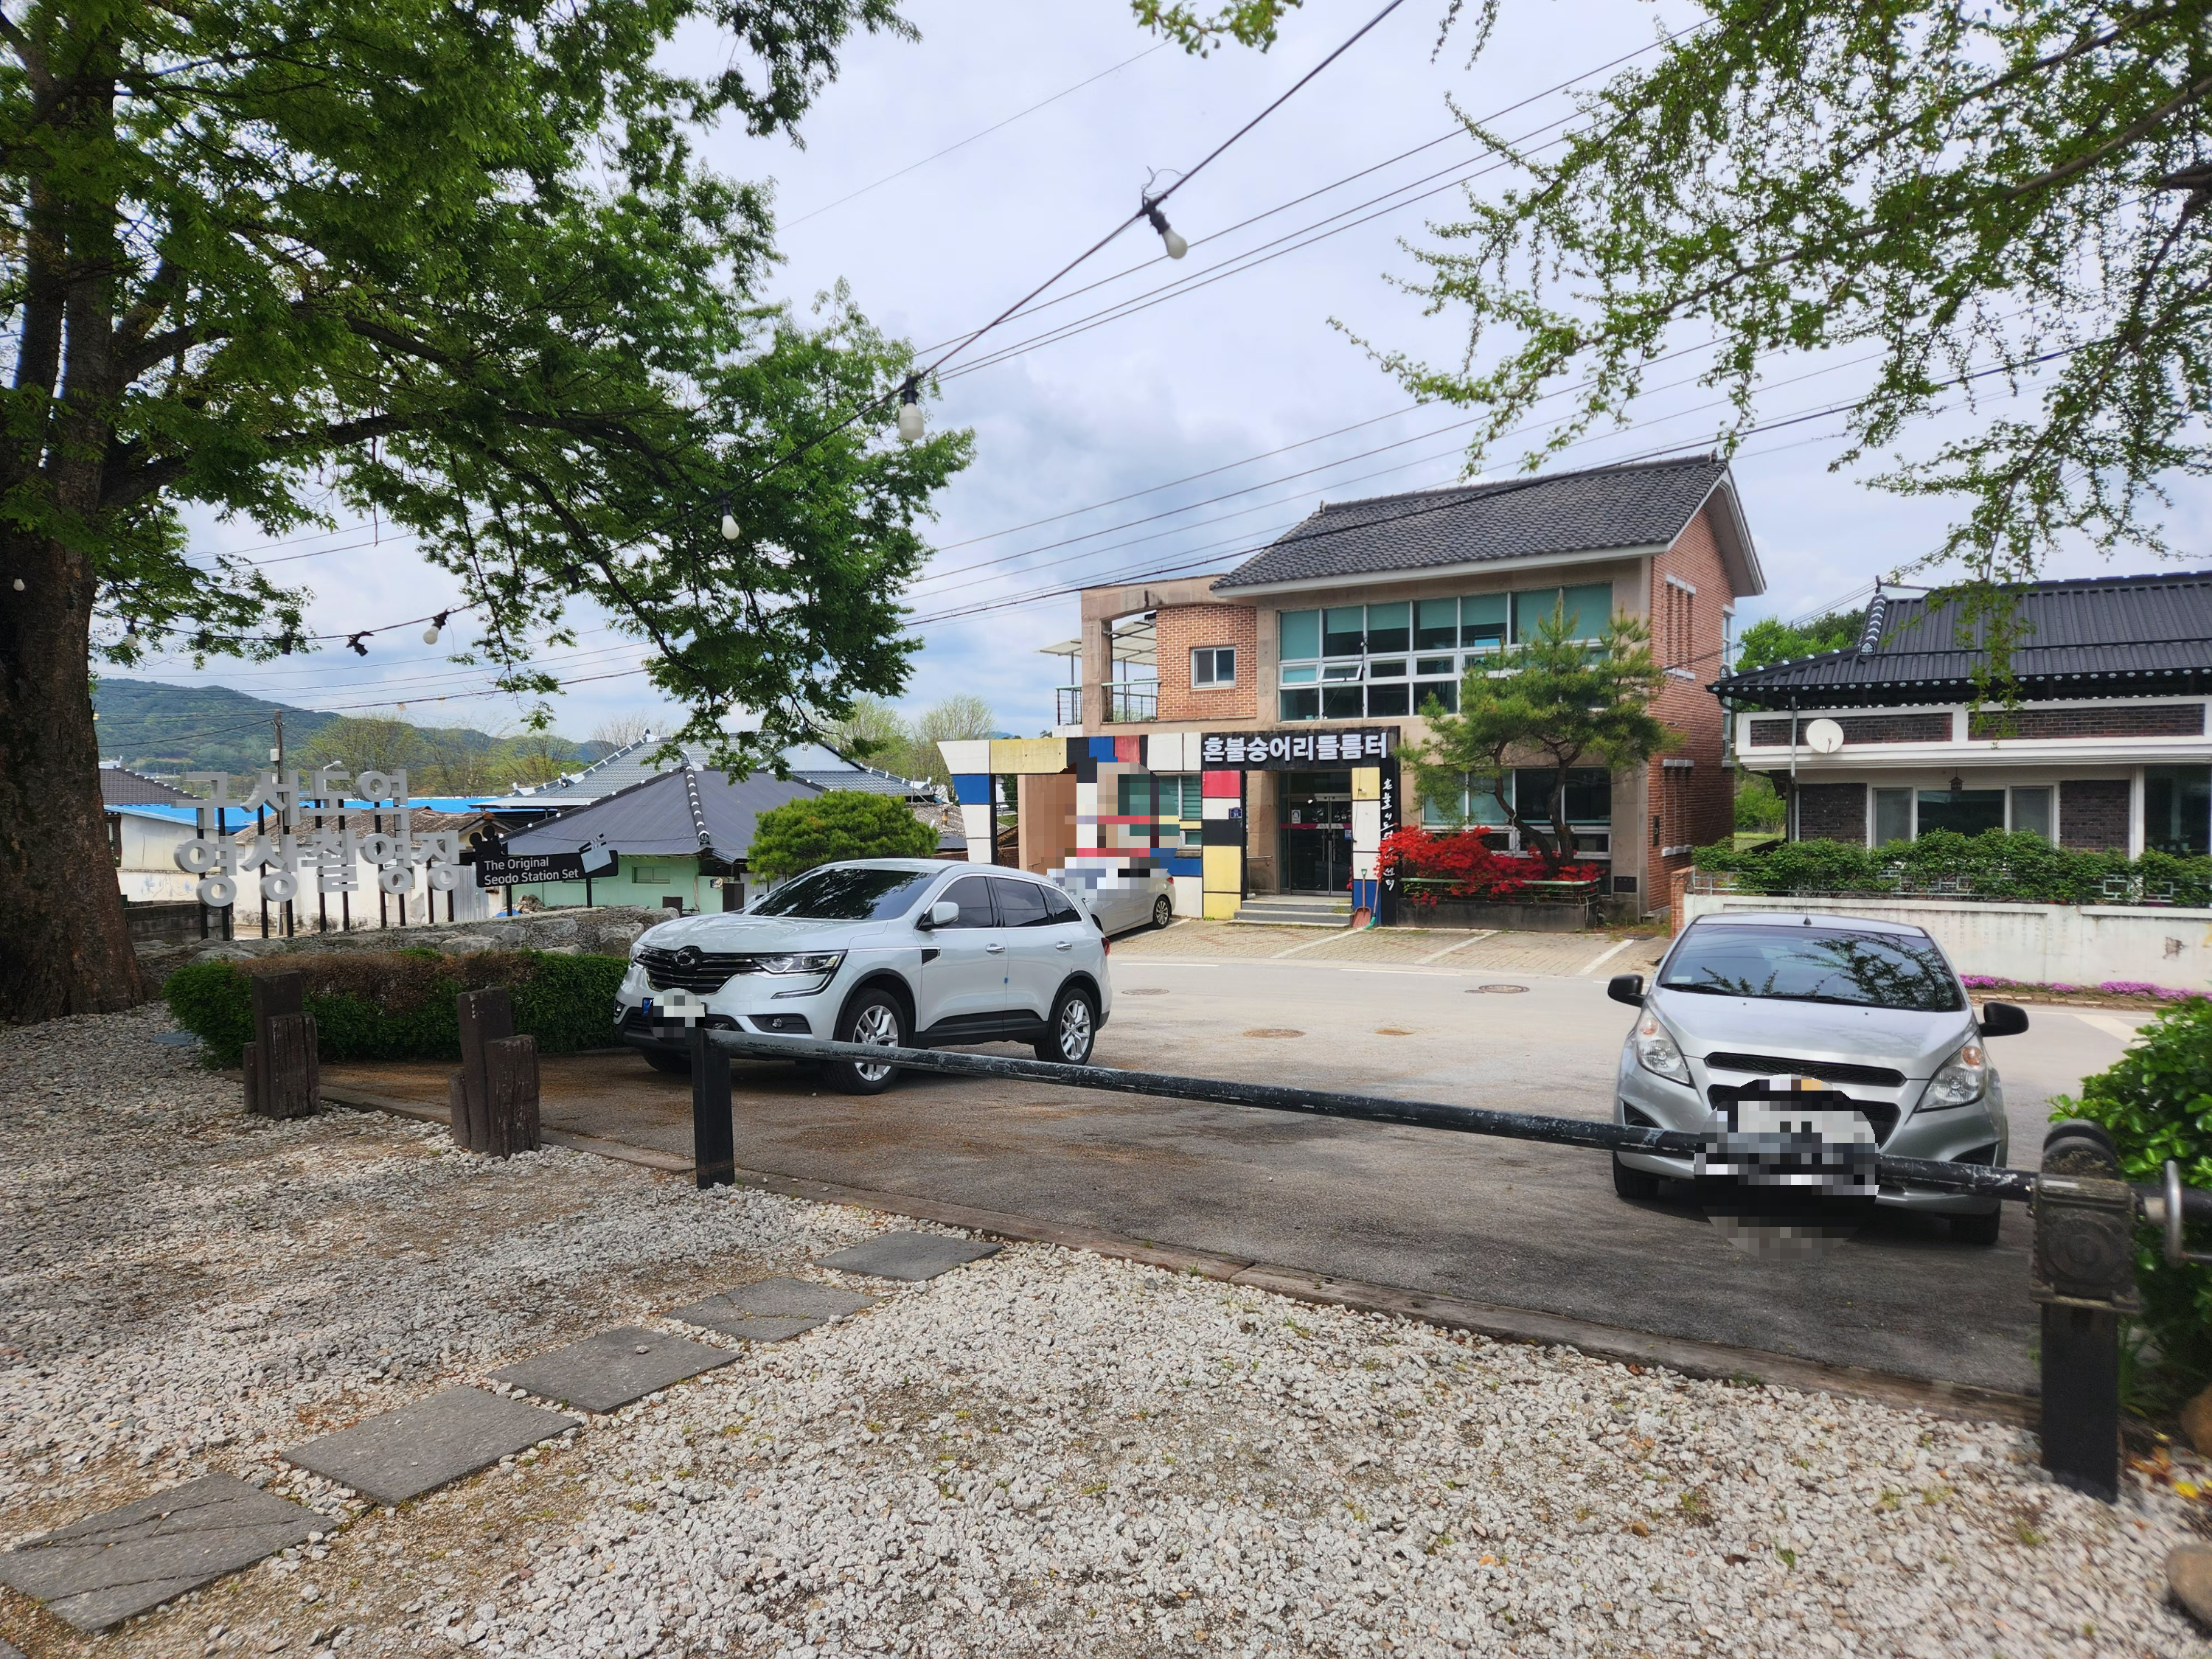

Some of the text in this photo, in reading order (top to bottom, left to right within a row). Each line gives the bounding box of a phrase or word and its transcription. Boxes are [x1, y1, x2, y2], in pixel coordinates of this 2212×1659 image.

[1203, 732, 1387, 762] 혼불숭어리들름터
[173, 828, 467, 907] 영상촬영장
[484, 856, 549, 871] The Original
[484, 869, 579, 886] Seodo Station Set
